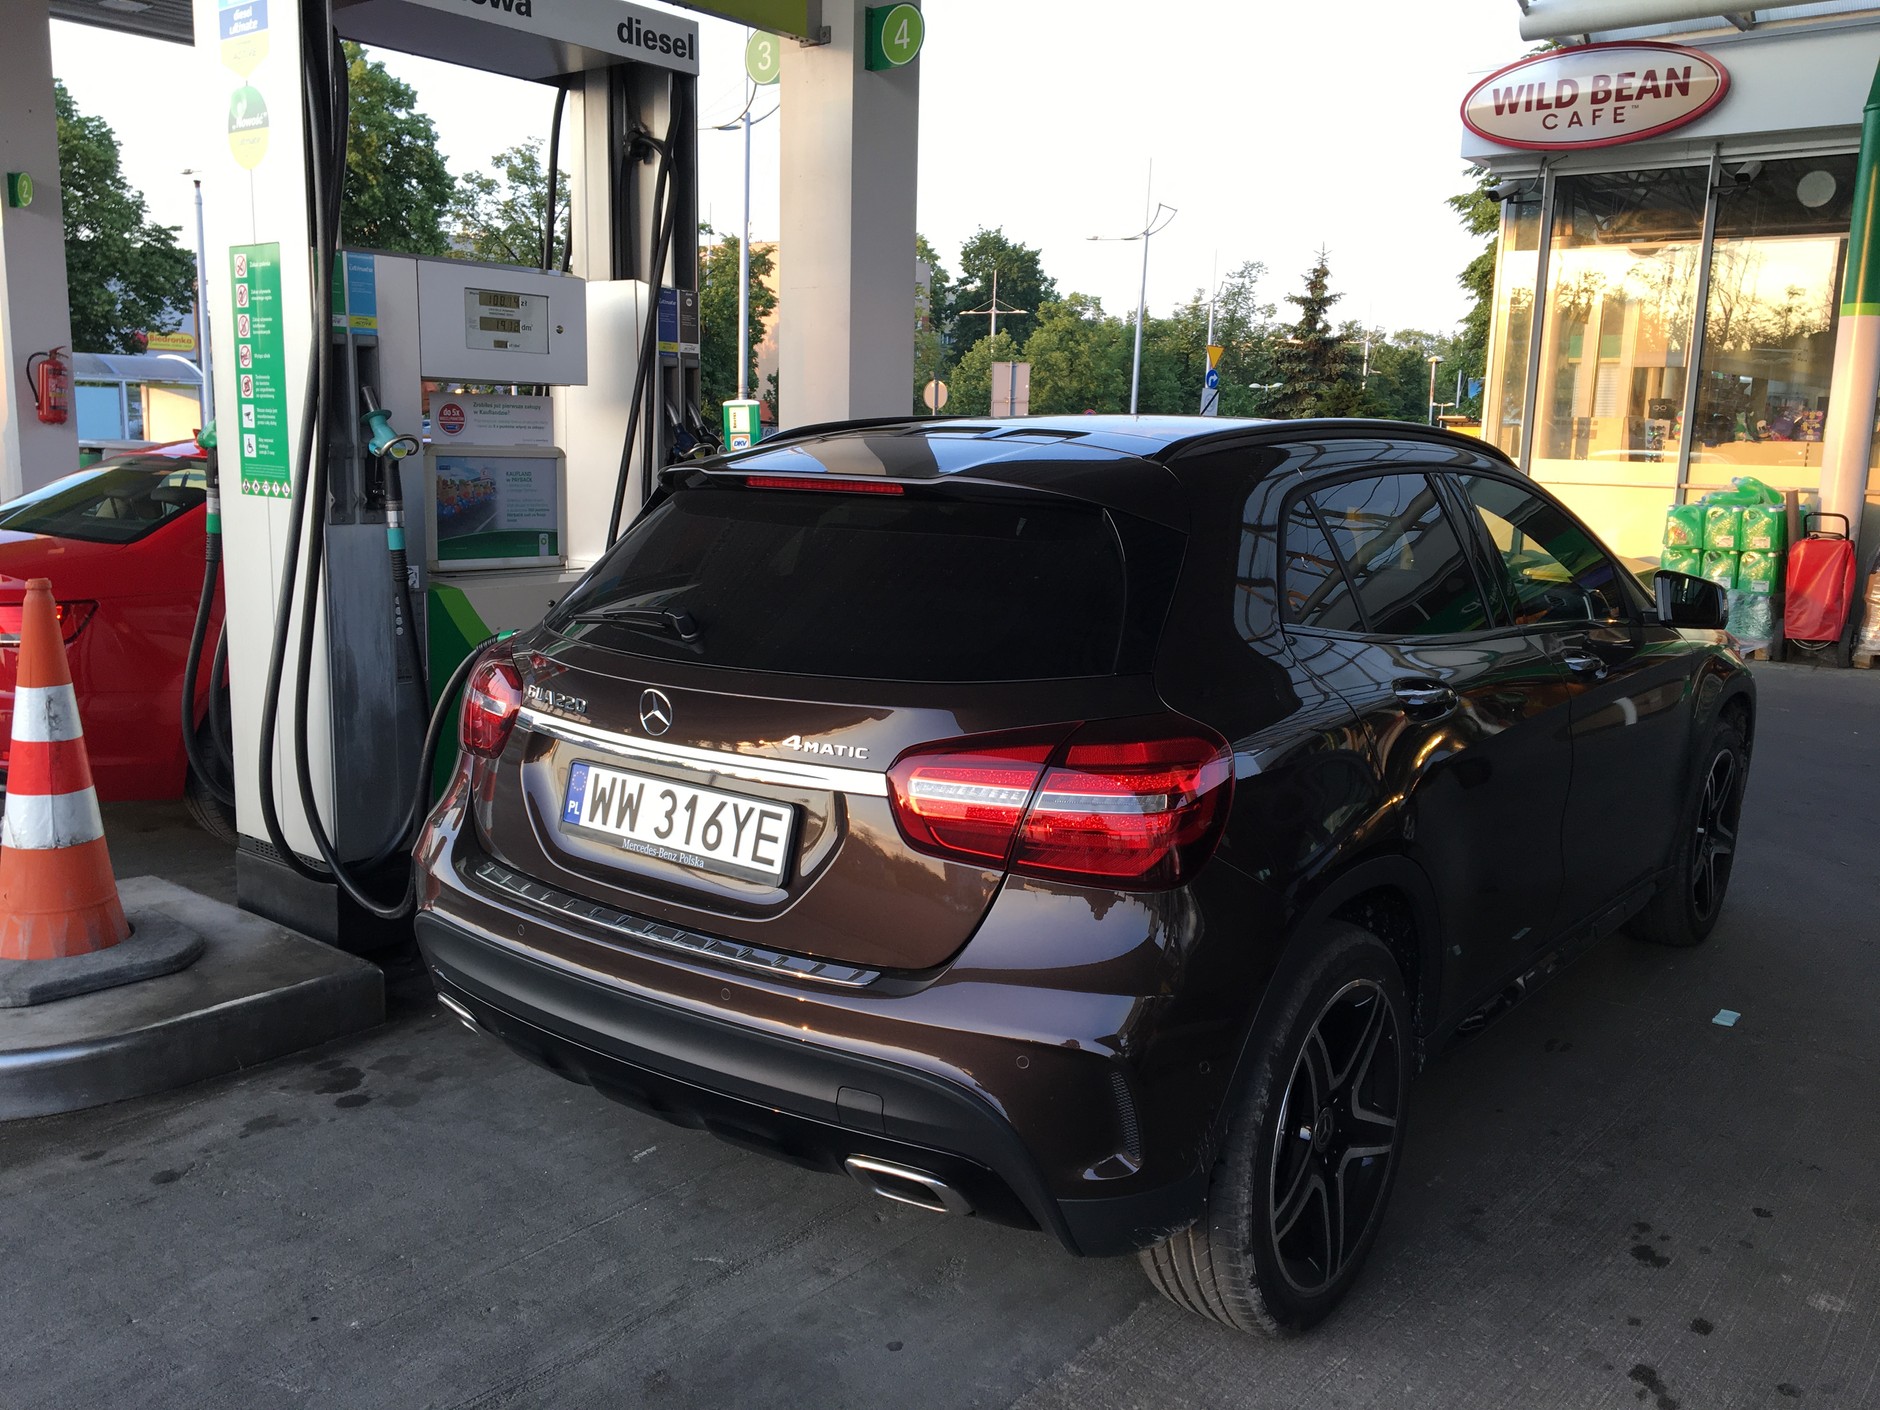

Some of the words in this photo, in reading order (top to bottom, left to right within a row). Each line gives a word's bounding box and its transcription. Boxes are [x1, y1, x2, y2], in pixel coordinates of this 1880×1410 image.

[617, 16, 695, 61] diesel
[894, 19, 910, 49] 4
[757, 41, 772, 70] 3
[1492, 78, 1579, 116] WILD
[1590, 66, 1692, 106] BEAN
[1542, 106, 1626, 130] CAFE
[21, 180, 29, 198] 2
[149, 334, 192, 345] Biedronka
[443, 407, 452, 416] do
[555, 692, 588, 714] 220
[781, 735, 870, 760] 4MATIC
[567, 799, 580, 815] PL
[588, 773, 645, 833] WW
[654, 789, 784, 867] 316YE
[622, 838, 678, 861] Mercedes-Benz
[679, 852, 704, 868] Polska
